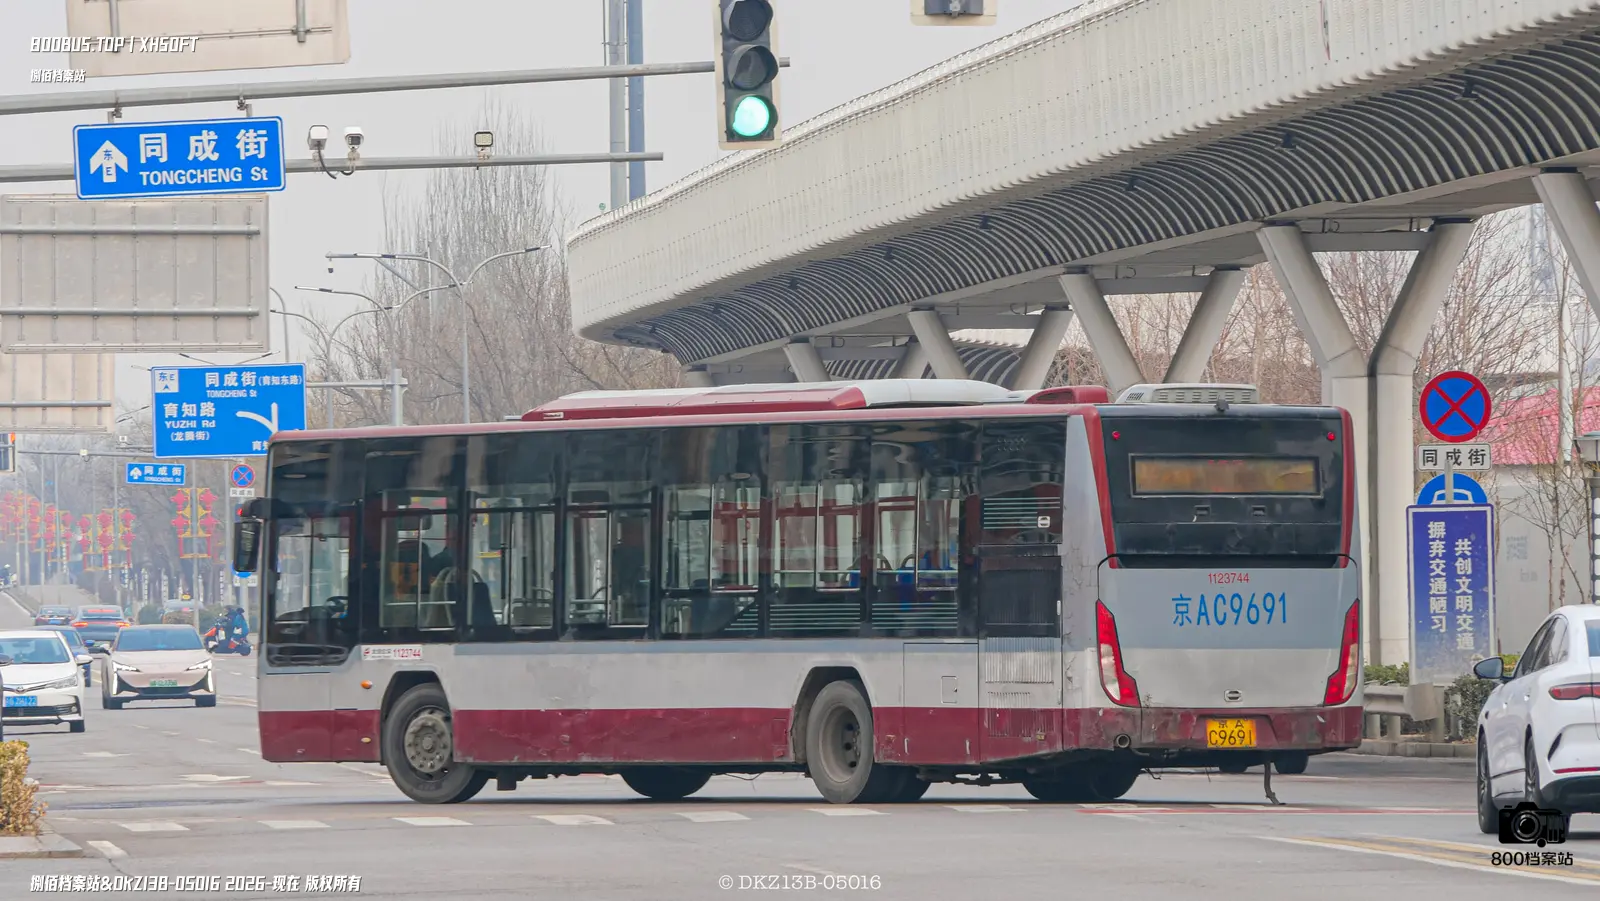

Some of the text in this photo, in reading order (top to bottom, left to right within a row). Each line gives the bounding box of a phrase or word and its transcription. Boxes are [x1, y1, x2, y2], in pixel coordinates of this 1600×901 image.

[139, 129, 268, 163] 同成街
[103, 149, 113, 161] 东
[106, 166, 112, 176] E
[139, 166, 268, 186] TONGCHENG St
[158, 372, 168, 382] 东
[205, 371, 257, 388] 同成街
[206, 389, 247, 398] TONGCHENG
[163, 402, 216, 418] 育知路
[164, 419, 216, 429] YUZHI Rd
[1422, 448, 1487, 467] 同成街
[1208, 573, 1250, 584] 1123744
[1427, 521, 1447, 633] 摒弃交通陋习
[1454, 538, 1475, 651] 共创文明交通
[1172, 592, 1287, 626] 京AC9691
[1235, 719, 1244, 729] A
[1209, 730, 1252, 746] C9691
